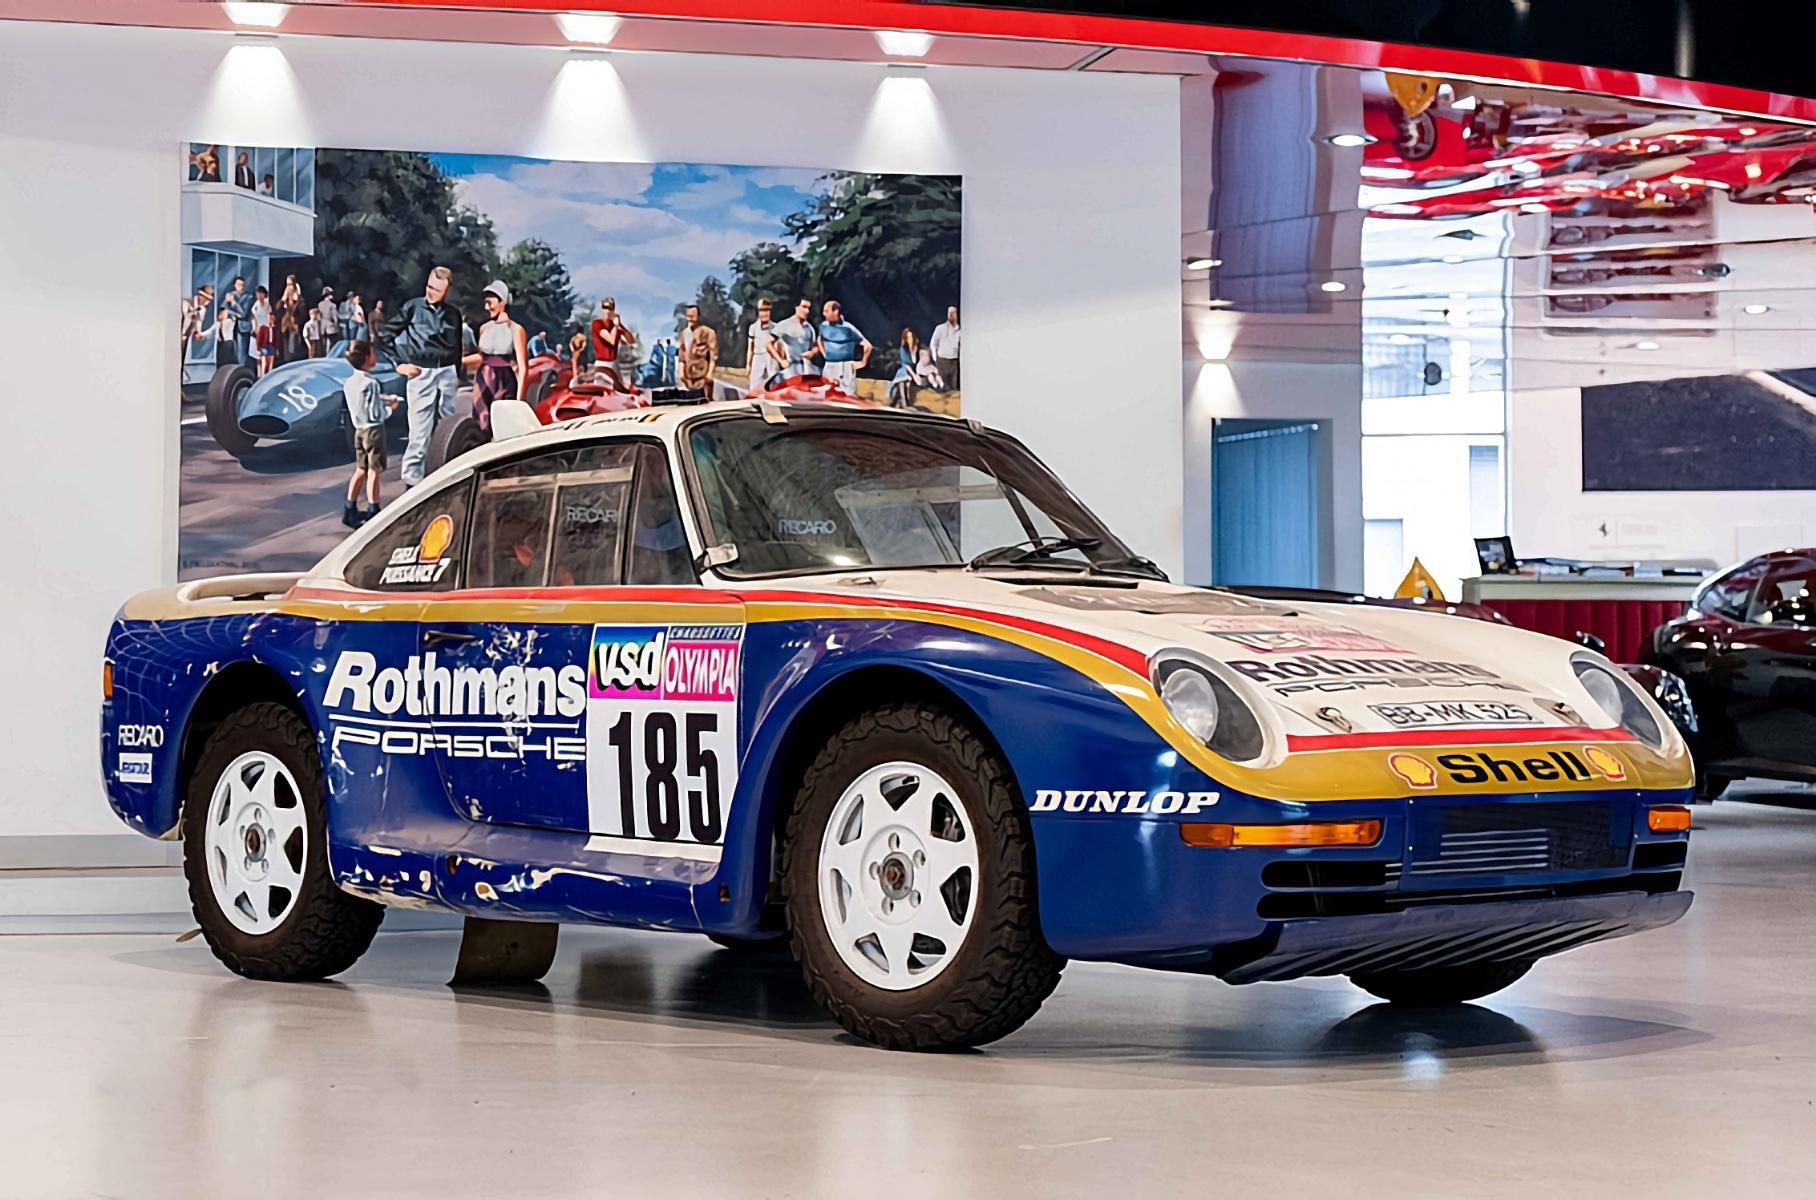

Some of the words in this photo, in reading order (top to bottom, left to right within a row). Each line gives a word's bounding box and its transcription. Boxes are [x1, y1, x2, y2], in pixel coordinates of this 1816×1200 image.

[278, 385, 318, 412] 18
[567, 506, 618, 523] RECAR
[322, 650, 587, 718] Rothmans
[665, 646, 737, 695] OLYMPIA
[1477, 703, 1534, 721] 525
[332, 725, 587, 761] PORSCHE
[608, 711, 722, 844] 185
[1436, 751, 1593, 784] Shell
[1029, 789, 1221, 815] DUNLOP
